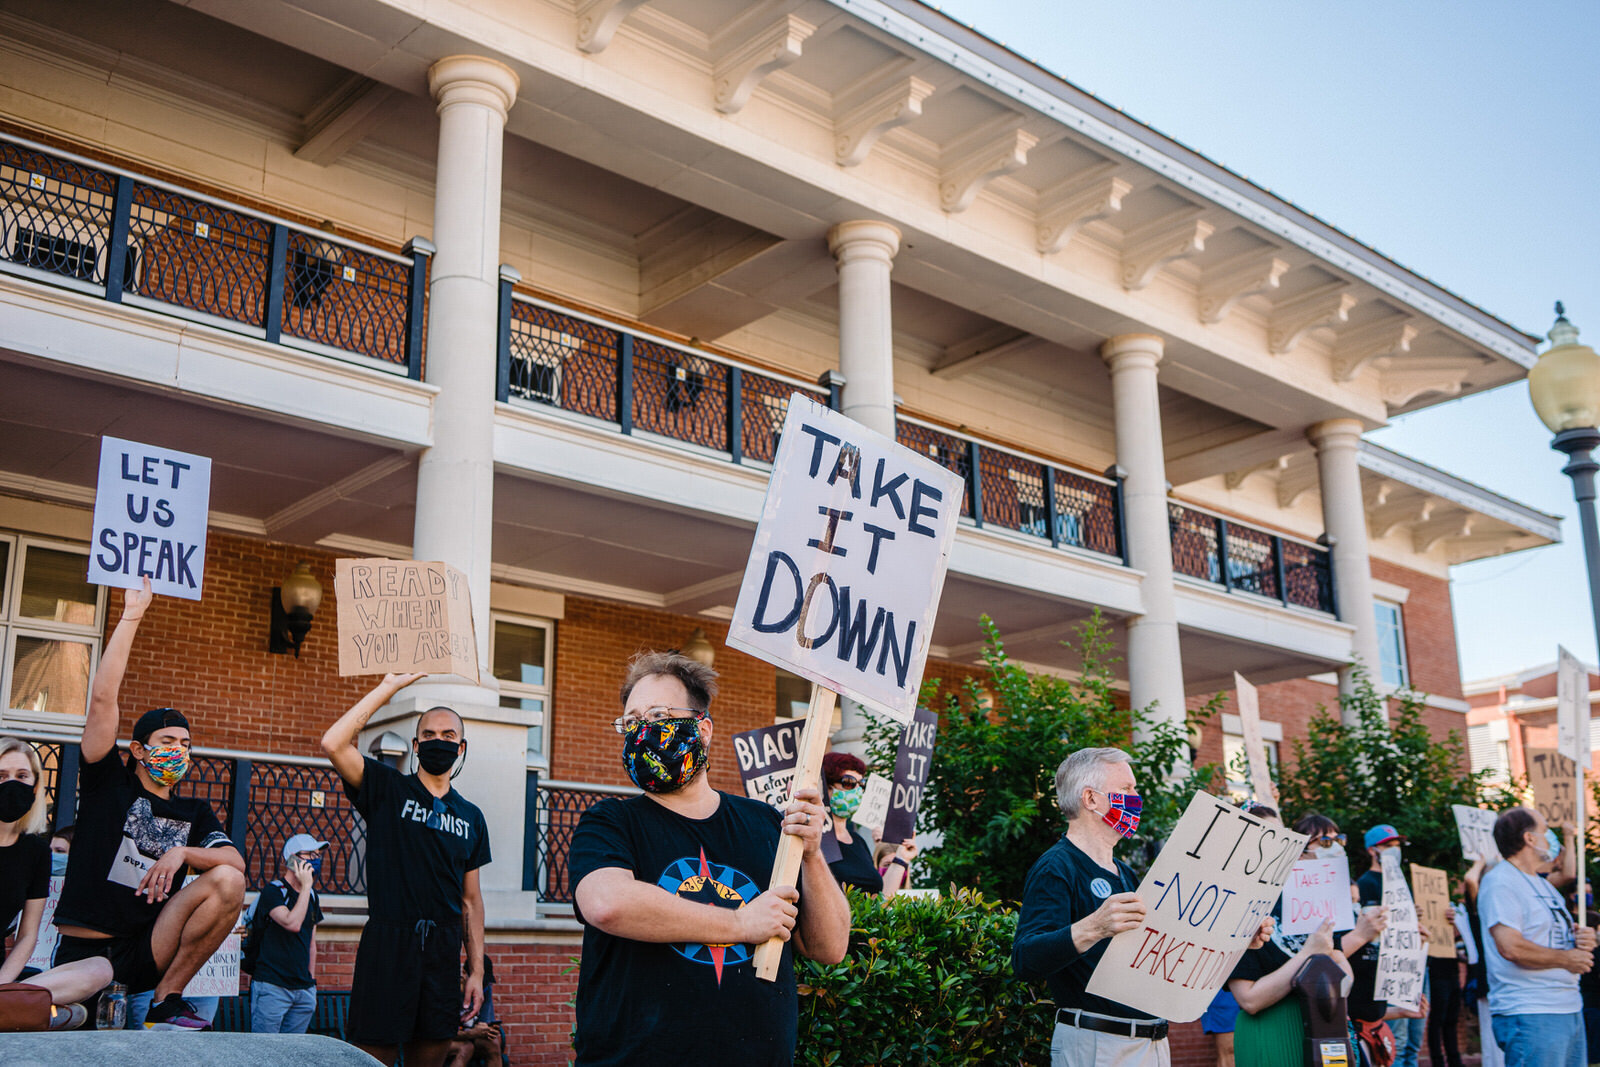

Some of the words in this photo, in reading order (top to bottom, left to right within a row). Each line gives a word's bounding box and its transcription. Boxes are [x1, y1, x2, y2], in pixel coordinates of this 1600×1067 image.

[121, 453, 190, 489] LET
[802, 423, 943, 538] TAKE
[127, 494, 175, 527] US
[97, 528, 198, 589] SPEAK
[806, 505, 895, 575] IT
[351, 566, 460, 600] READY
[356, 600, 442, 631] WHEN
[752, 550, 916, 689] DOWN
[352, 633, 399, 669] YOU
[413, 630, 469, 664] ARE!
[904, 721, 935, 750] TAKE
[907, 753, 927, 782] IT
[1552, 783, 1570, 799] IT
[401, 799, 470, 840] FEMNIST
[1186, 804, 1276, 876] IT'S
[1292, 868, 1320, 888] TAKE
[1322, 863, 1337, 883] IT
[1130, 927, 1195, 983] TAKE
[1182, 946, 1215, 989] IT
